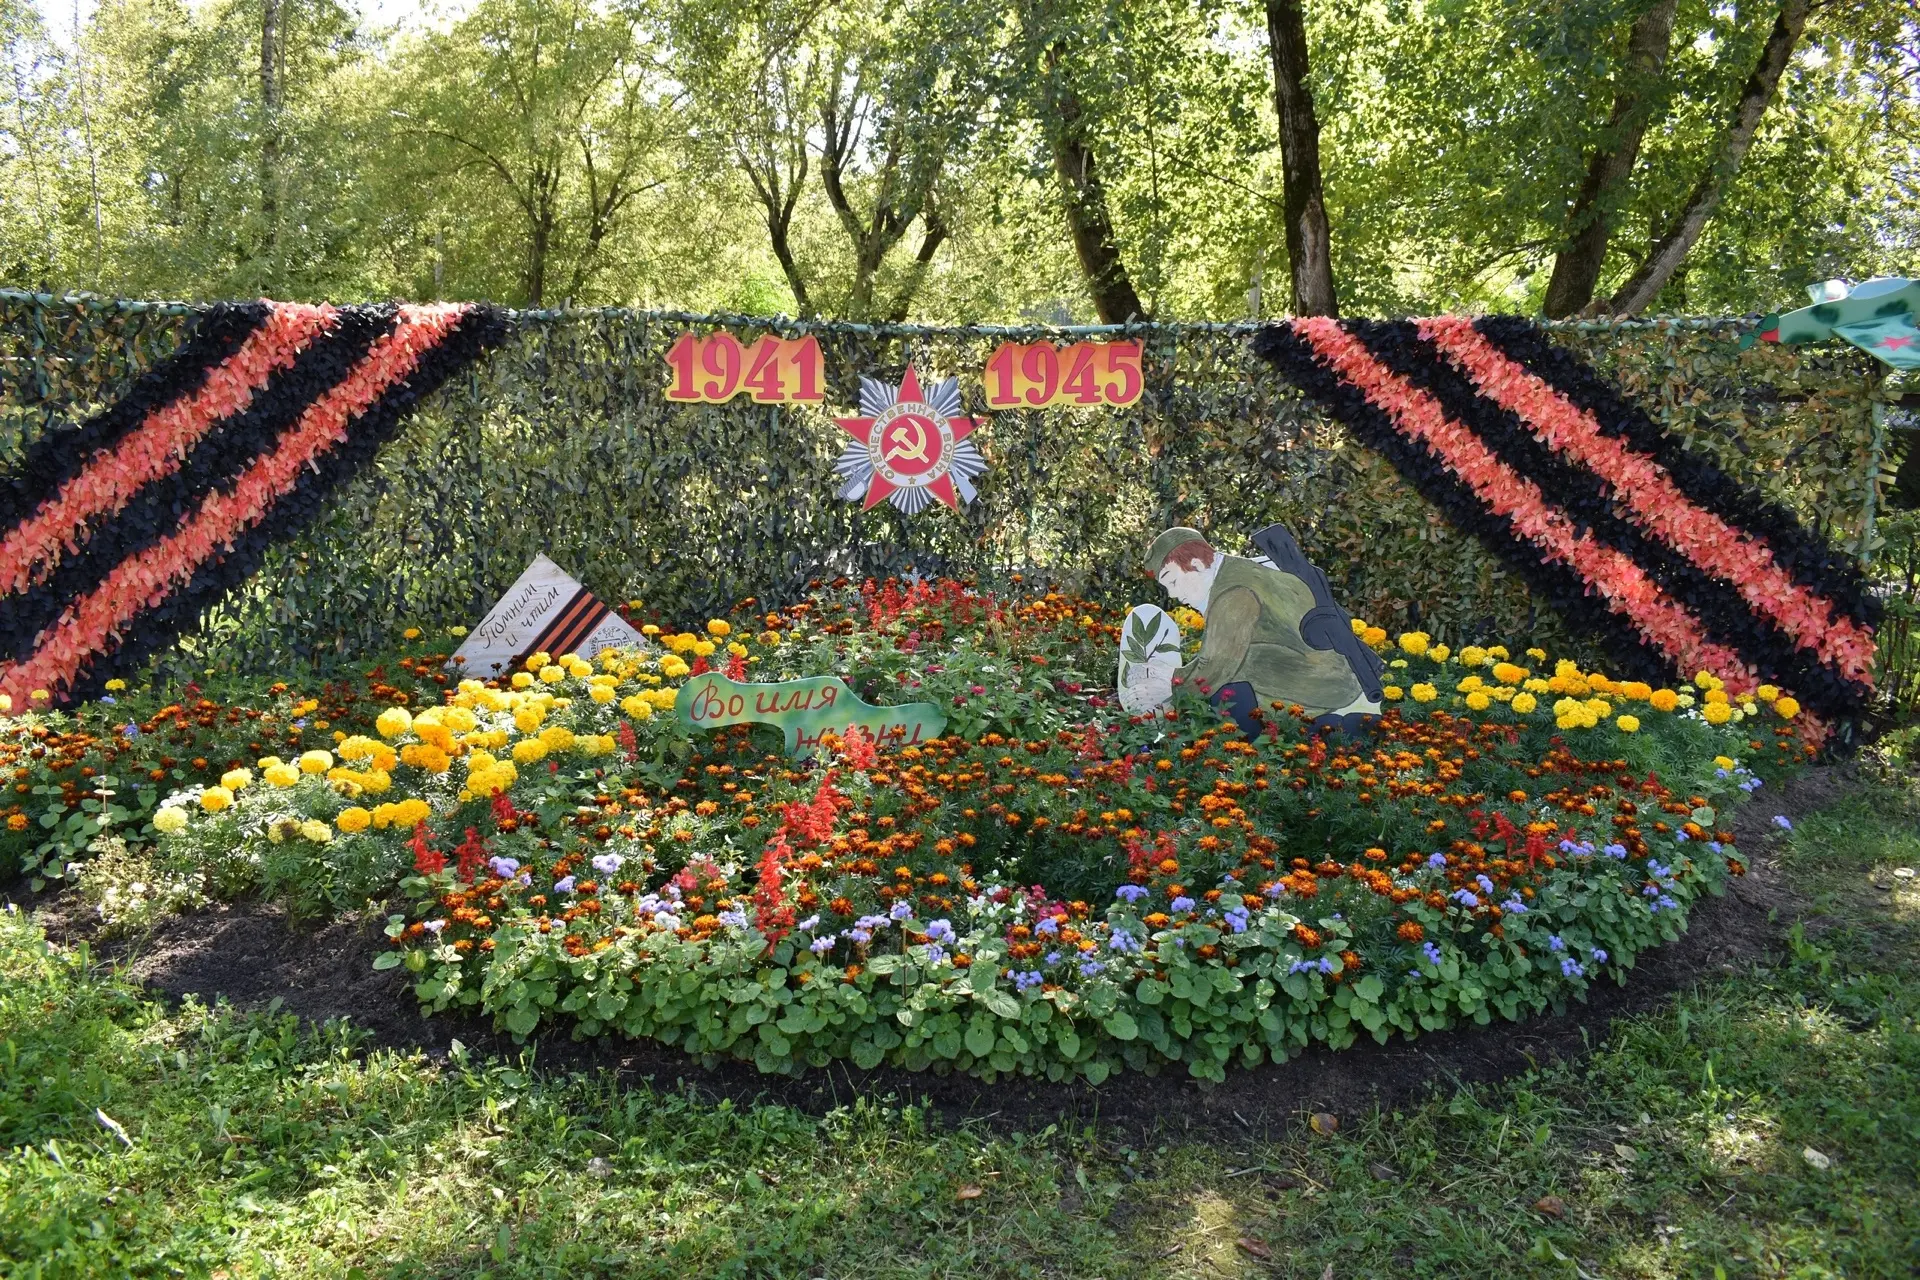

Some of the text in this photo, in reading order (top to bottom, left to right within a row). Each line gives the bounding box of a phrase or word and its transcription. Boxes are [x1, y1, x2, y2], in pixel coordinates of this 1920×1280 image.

[669, 331, 825, 401] 1941
[990, 341, 1142, 405] 1945
[870, 403, 947, 480] ОТЕЧЕСТВЕННАЯ
[479, 583, 538, 650] Помним
[504, 586, 561, 648] и чтим
[690, 678, 838, 722] Во имя
